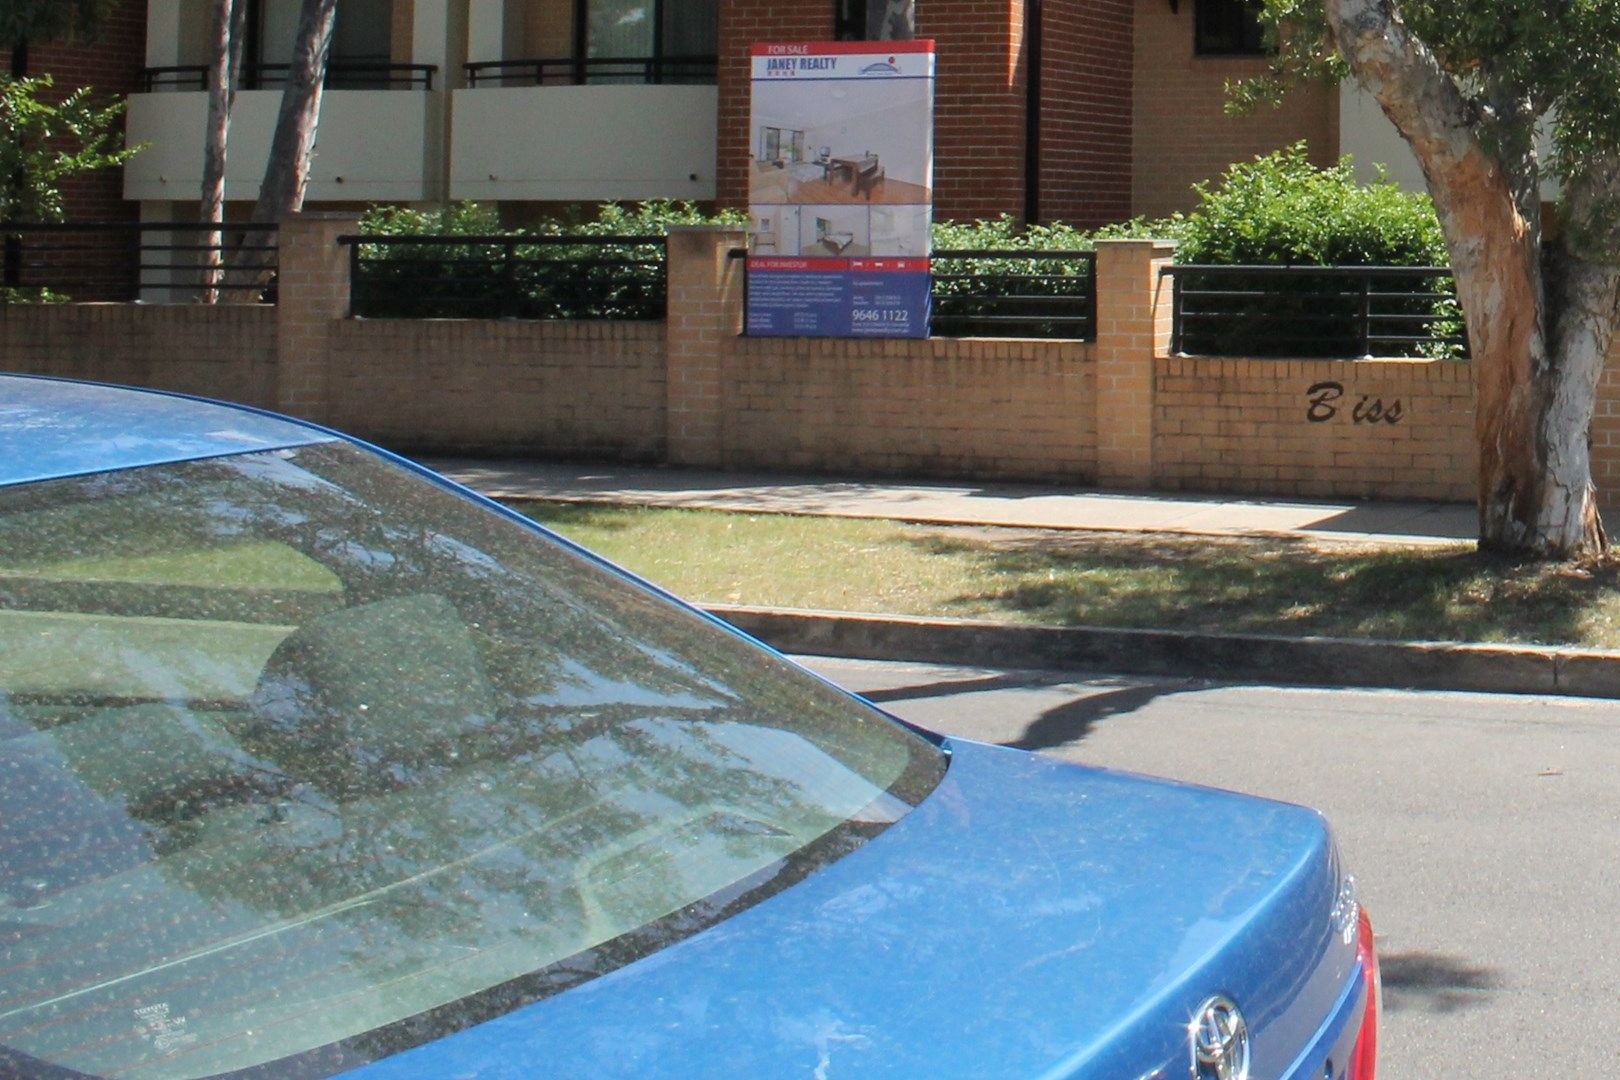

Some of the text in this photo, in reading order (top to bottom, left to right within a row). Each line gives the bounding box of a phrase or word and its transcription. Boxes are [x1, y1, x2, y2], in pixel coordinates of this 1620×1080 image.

[768, 44, 808, 54] FOR SALE
[800, 57, 837, 70] REALTY
[852, 309, 908, 321] 9646 1122
